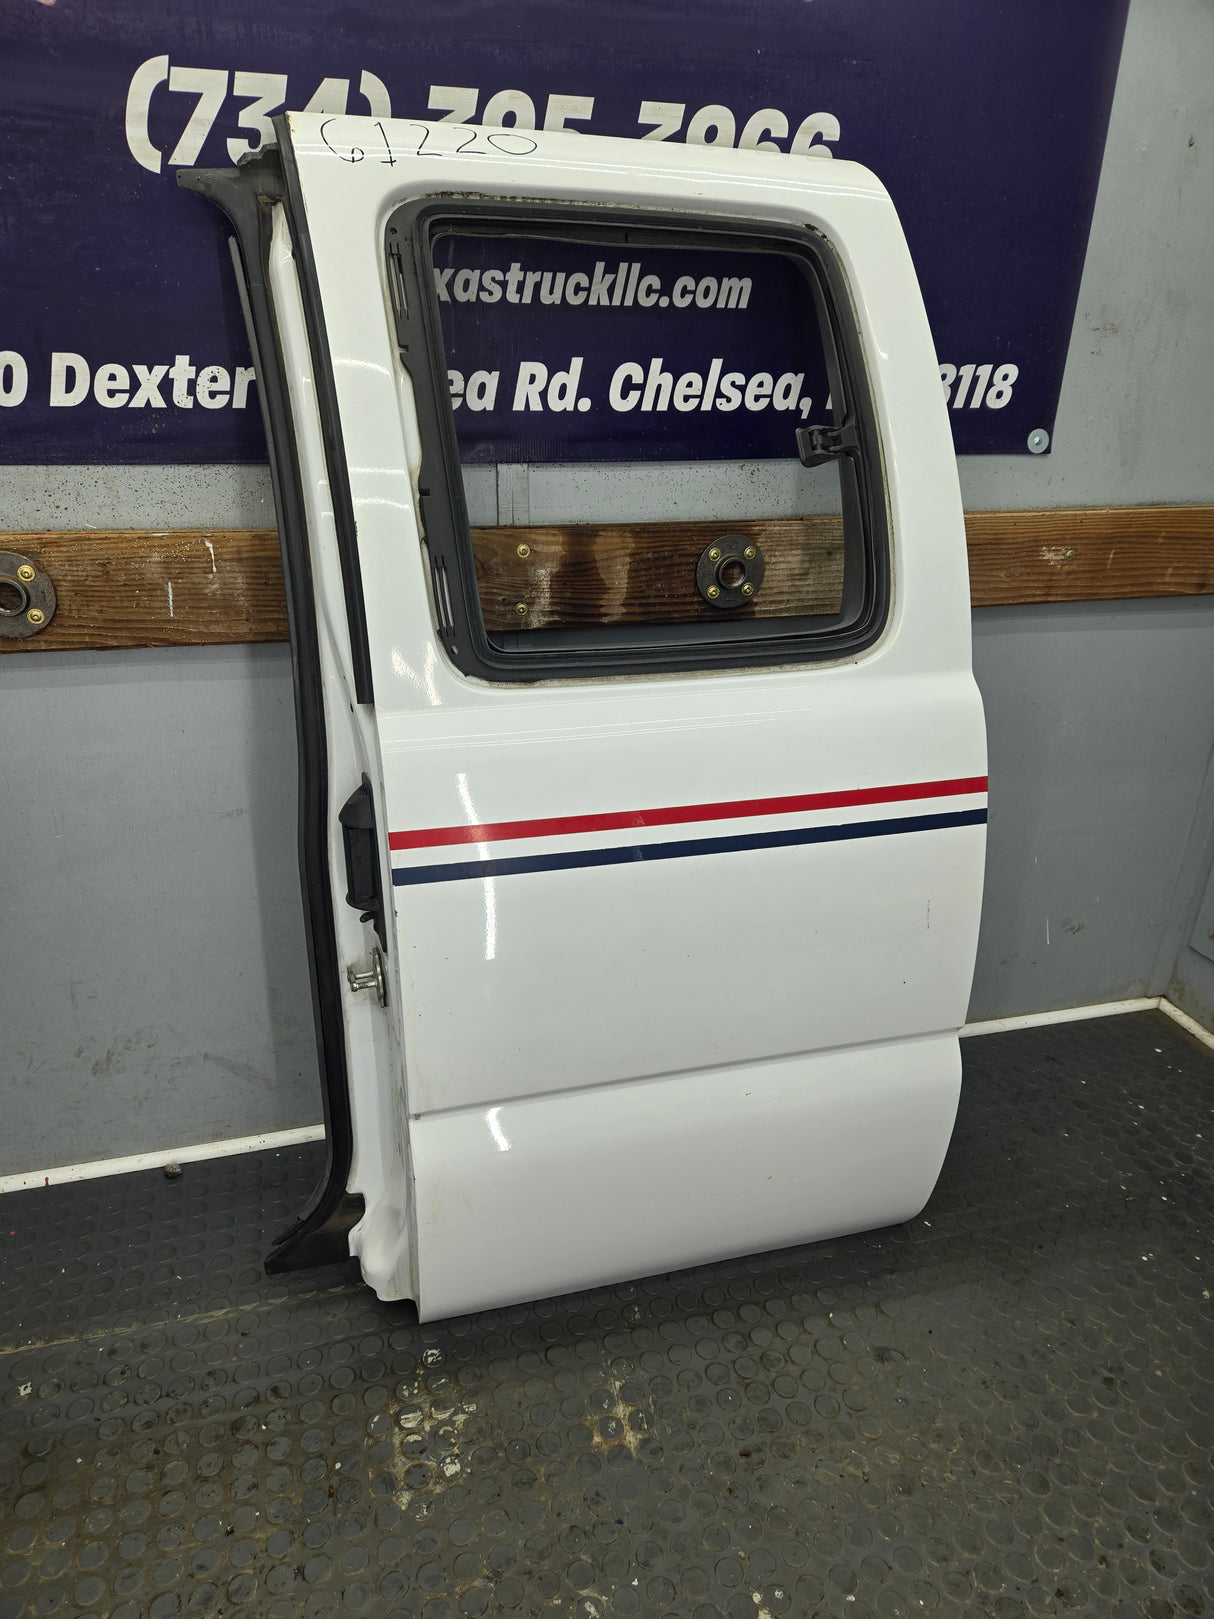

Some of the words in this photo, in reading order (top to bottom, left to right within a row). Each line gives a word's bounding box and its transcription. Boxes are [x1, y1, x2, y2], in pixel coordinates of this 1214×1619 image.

[50, 351, 257, 409] Dexter
[512, 356, 592, 412] Rd.
[608, 357, 813, 420] Chelsea,
